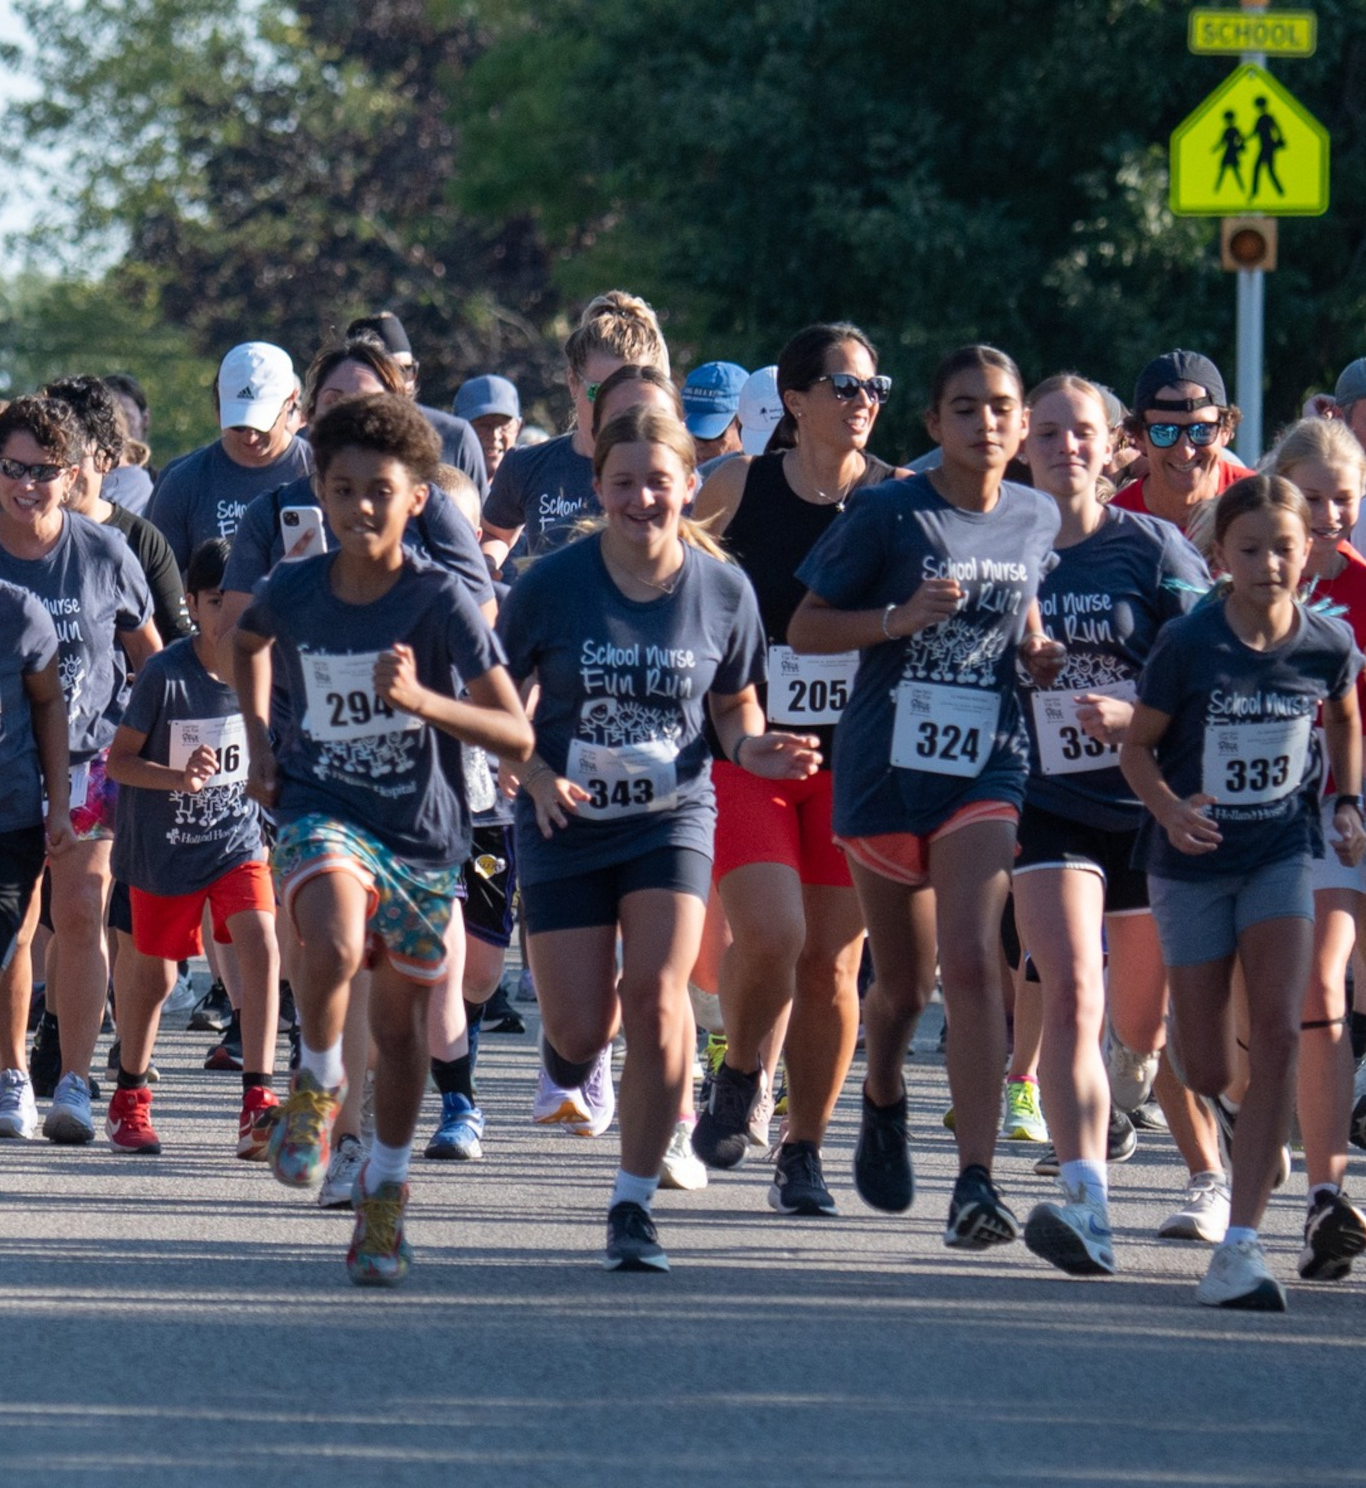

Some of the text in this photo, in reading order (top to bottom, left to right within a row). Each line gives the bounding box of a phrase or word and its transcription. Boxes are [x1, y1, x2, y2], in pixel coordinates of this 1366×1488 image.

[1201, 22, 1301, 47] SCHOOL
[56, 620, 84, 644] un
[1064, 614, 1115, 645] Run
[580, 639, 639, 668] School
[580, 667, 694, 699] Fun Run
[787, 679, 848, 712] 205
[1207, 689, 1261, 717] School
[916, 721, 980, 763] 324
[215, 744, 240, 775] 16
[1225, 755, 1290, 793] 333
[588, 778, 654, 810] 343
